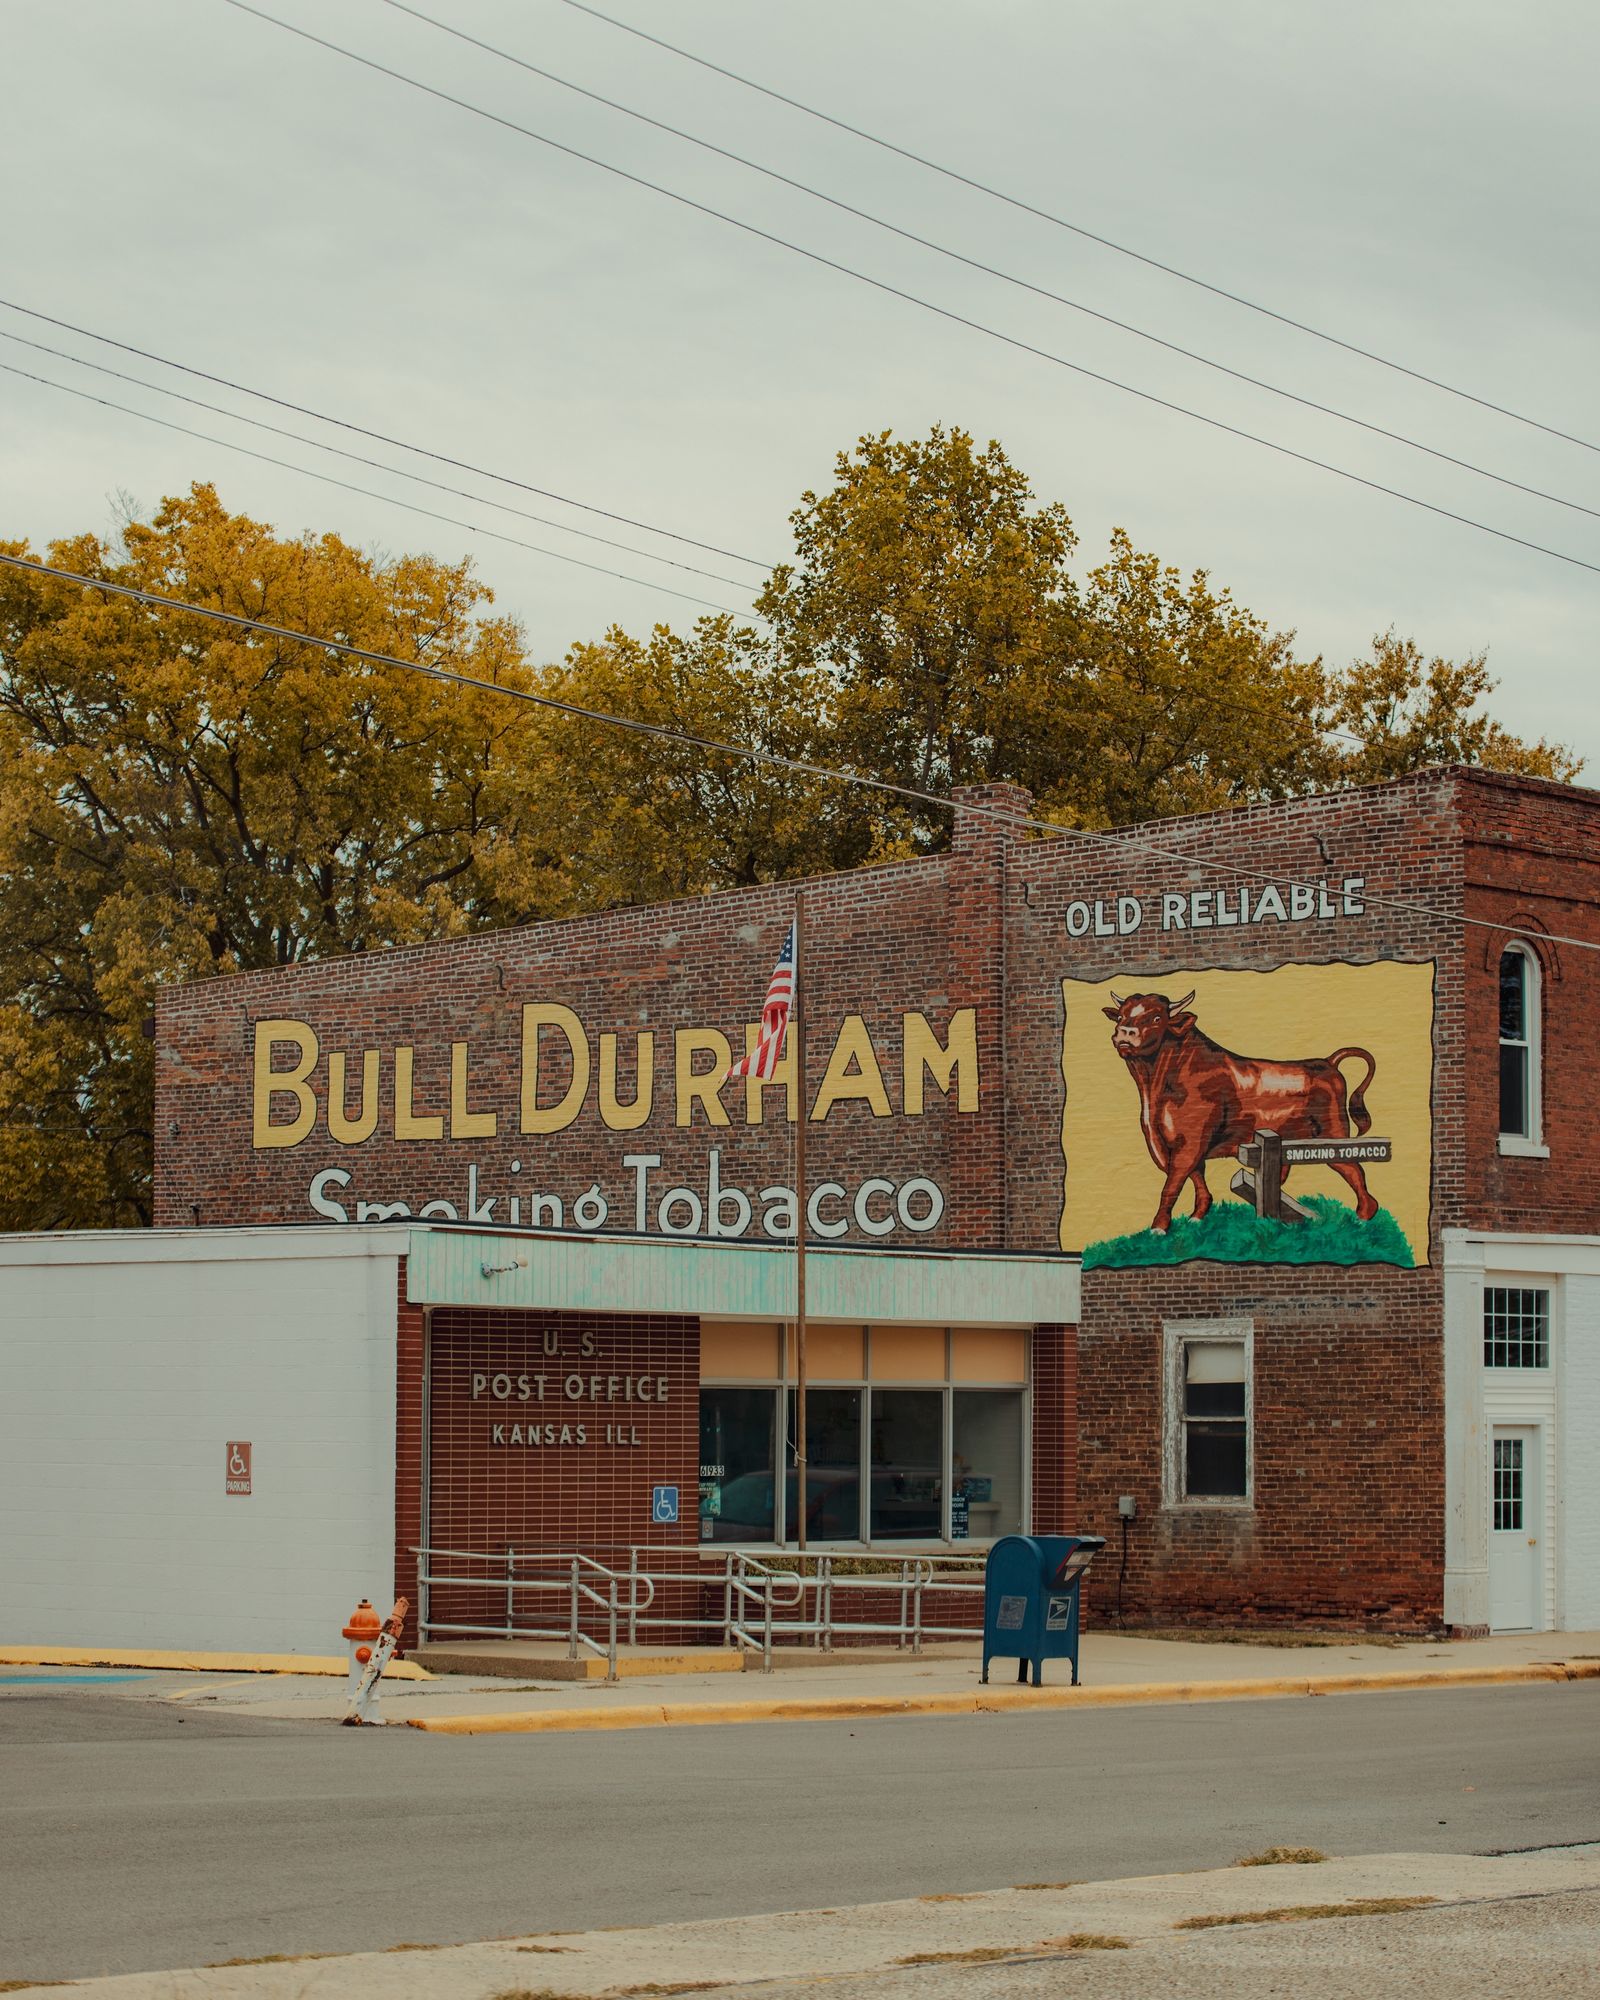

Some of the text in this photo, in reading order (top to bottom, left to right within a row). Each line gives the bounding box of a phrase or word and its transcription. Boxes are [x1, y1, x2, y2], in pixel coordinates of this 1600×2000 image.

[1065, 876, 1366, 938] OLD RELIABLE
[252, 1001, 981, 1150] BULL DURHAM
[1286, 1146, 1387, 1160] SMOKING TOBACCO
[622, 1149, 945, 1240] Tobacco
[473, 1374, 670, 1402] POST OFFICE
[492, 1423, 642, 1446] KANSAS ILL
[701, 1466, 724, 1476] 61933
[227, 1481, 250, 1491] PARKING
